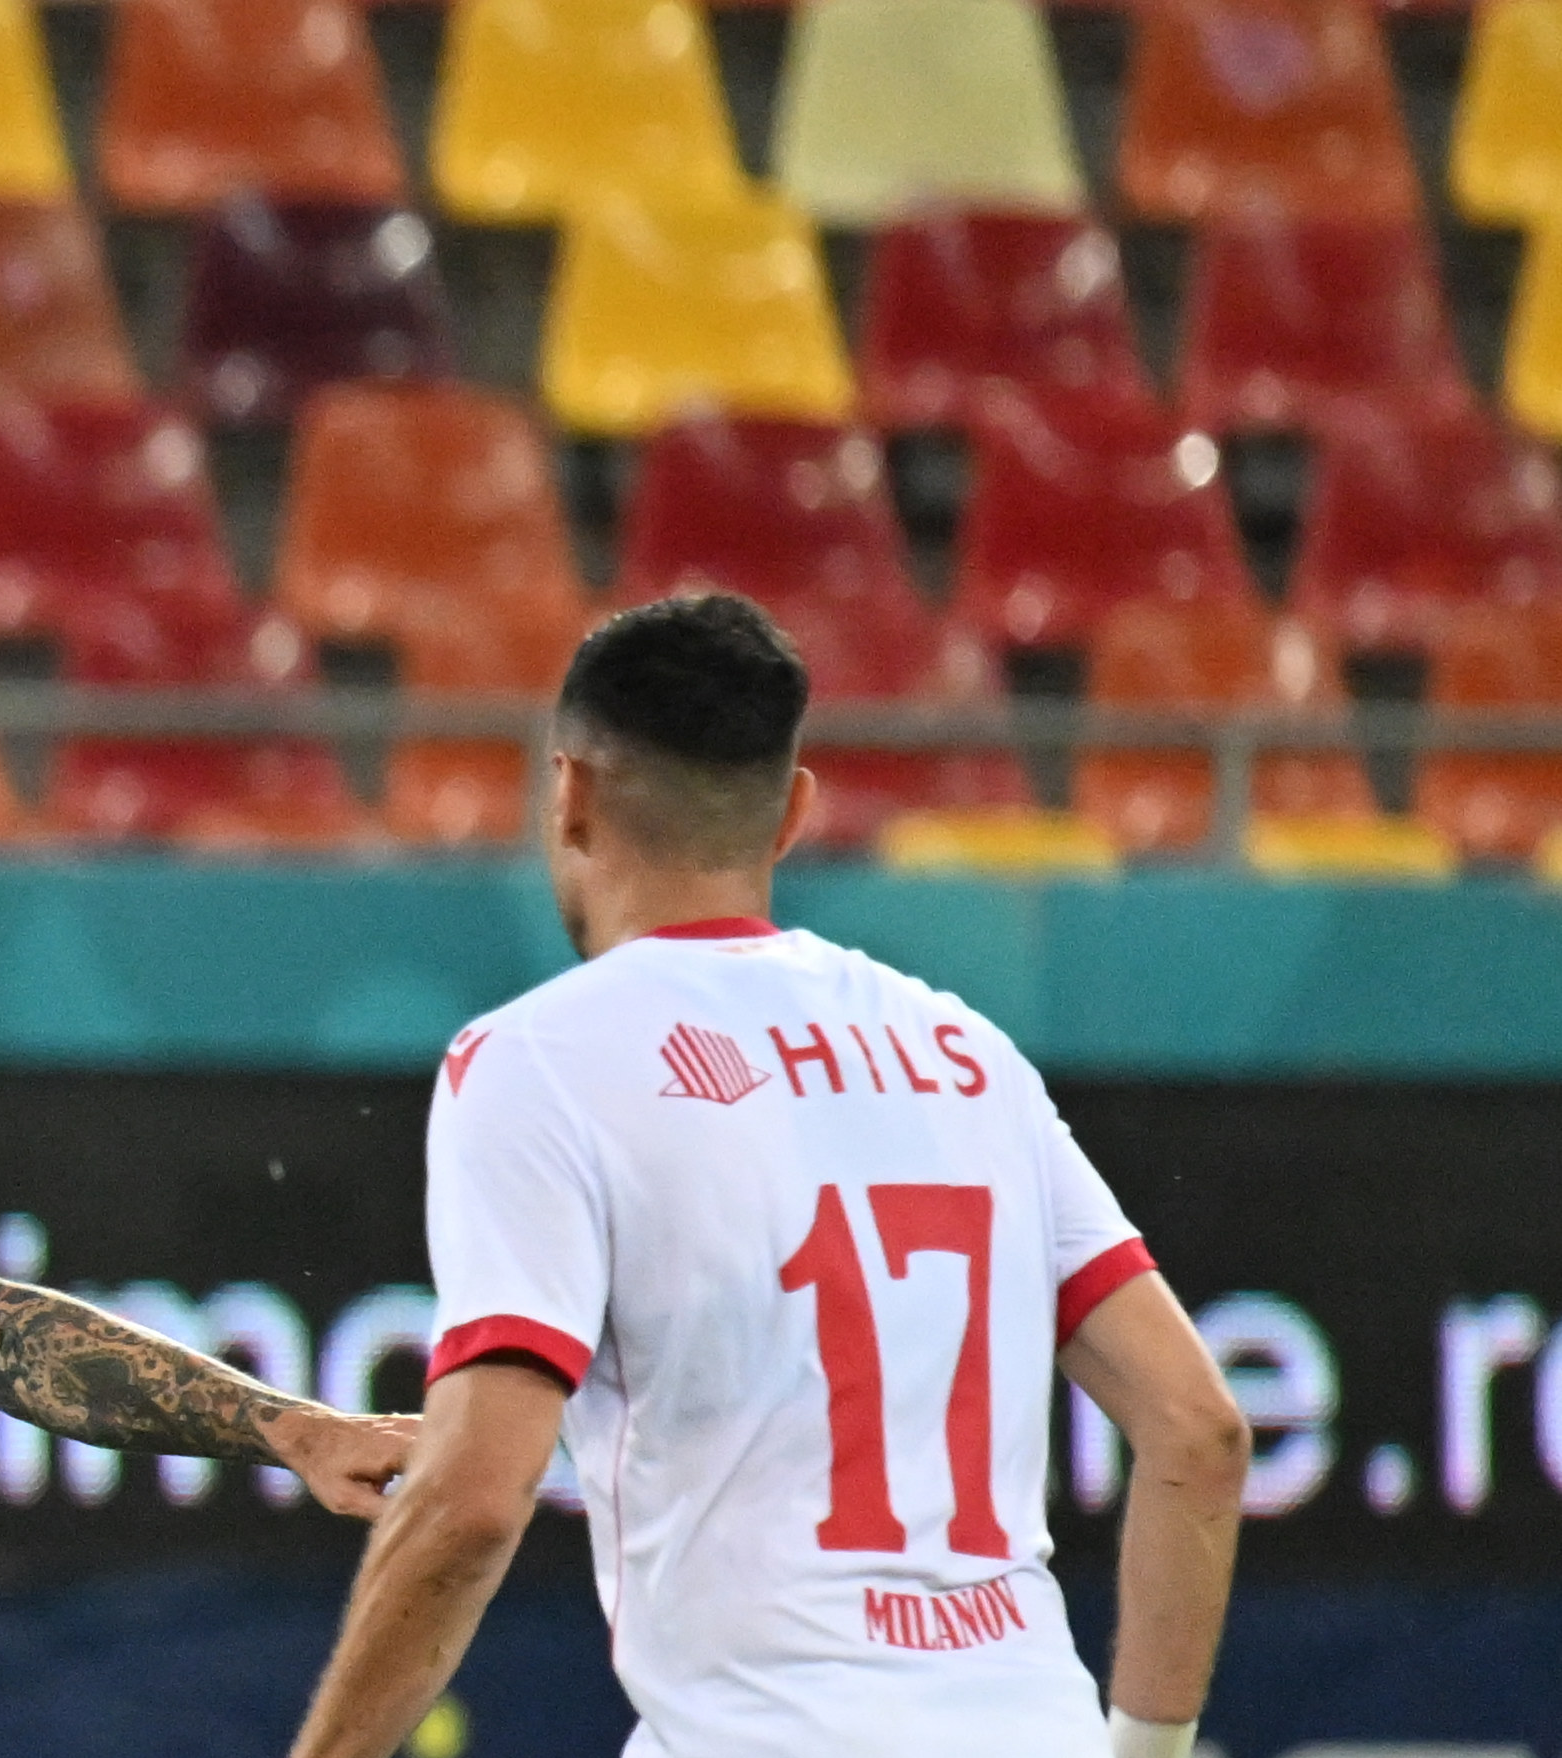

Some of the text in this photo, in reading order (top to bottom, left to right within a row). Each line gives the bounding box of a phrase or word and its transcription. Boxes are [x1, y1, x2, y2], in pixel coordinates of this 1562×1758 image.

[766, 1021, 988, 1099] HILS
[778, 1183, 1012, 1561] 17
[863, 1573, 1027, 1652] MILANOV
